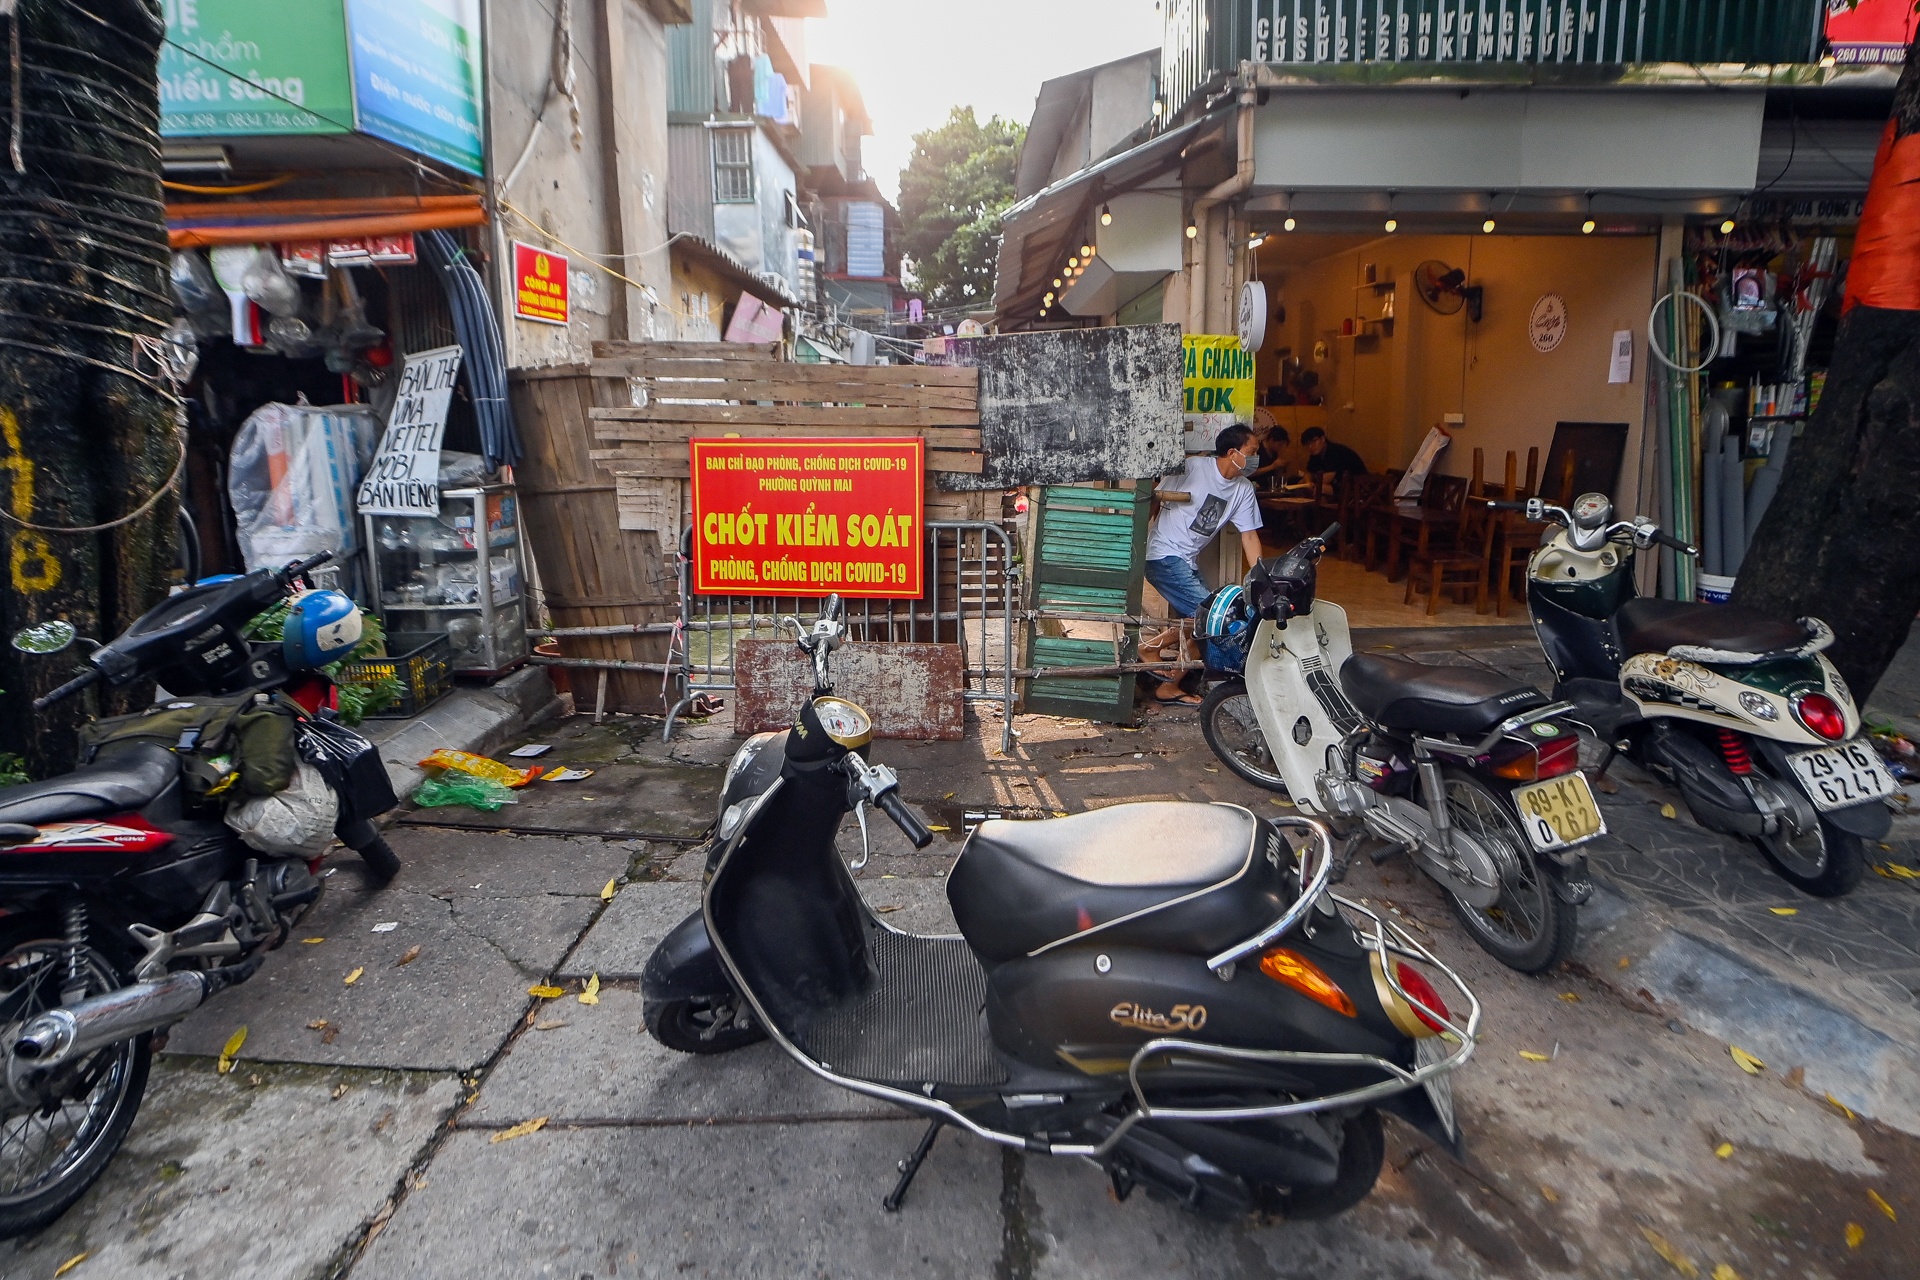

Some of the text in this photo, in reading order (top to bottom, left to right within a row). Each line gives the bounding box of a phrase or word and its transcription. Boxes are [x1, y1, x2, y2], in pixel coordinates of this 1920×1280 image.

[1441, 35, 1494, 59] KIM
[524, 275, 561, 295] CÔNG AN
[1202, 347, 1253, 380] CHANH
[1184, 386, 1235, 412] 10K
[706, 453, 907, 473] BAN CHỈ ĐẠO PHÒNG, CHỐNG DỊCH COVID-19
[759, 475, 853, 493] PHƯỜNG QUỲNH MAI
[703, 501, 912, 548] CHỐT KIỂM SOÁT
[710, 553, 907, 586] PHÒNG, CHỐNG DỊCH COVID-19
[1500, 691, 1537, 704] HONDA
[1802, 745, 1869, 778] 29-Y6
[1527, 779, 1582, 815] 89-K1
[1818, 769, 1882, 802] 6247
